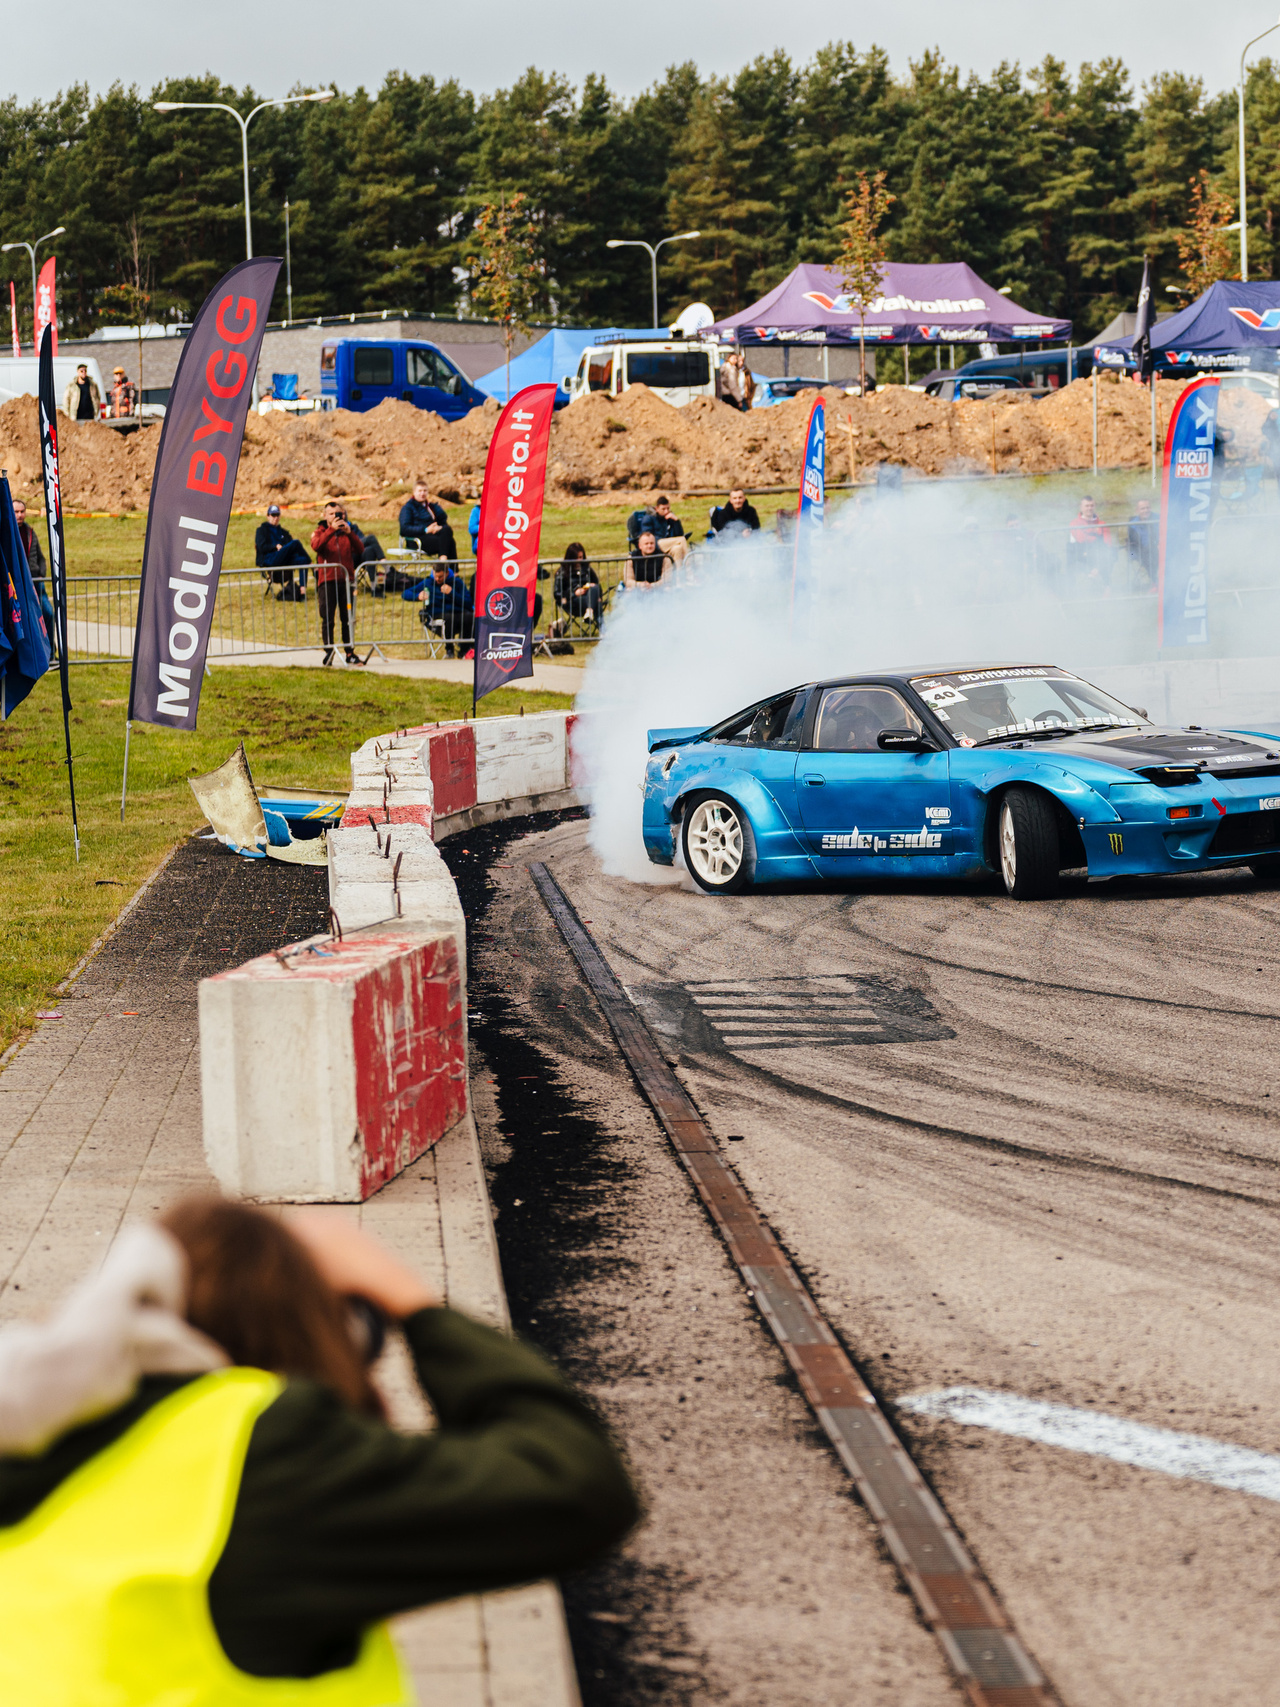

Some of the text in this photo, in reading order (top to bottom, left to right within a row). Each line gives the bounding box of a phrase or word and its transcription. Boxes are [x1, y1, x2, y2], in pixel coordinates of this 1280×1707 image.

[1191, 354, 1251, 367] Valvoline
[186, 294, 259, 498] BYGG
[1176, 464, 1209, 477] MOLY
[1178, 451, 1207, 464] LIQUI
[498, 408, 535, 582] ovigreta.lt
[1184, 533, 1208, 645] LIQUI
[156, 515, 220, 718] Modul
[934, 690, 956, 701] 40
[822, 824, 942, 853] side to side
